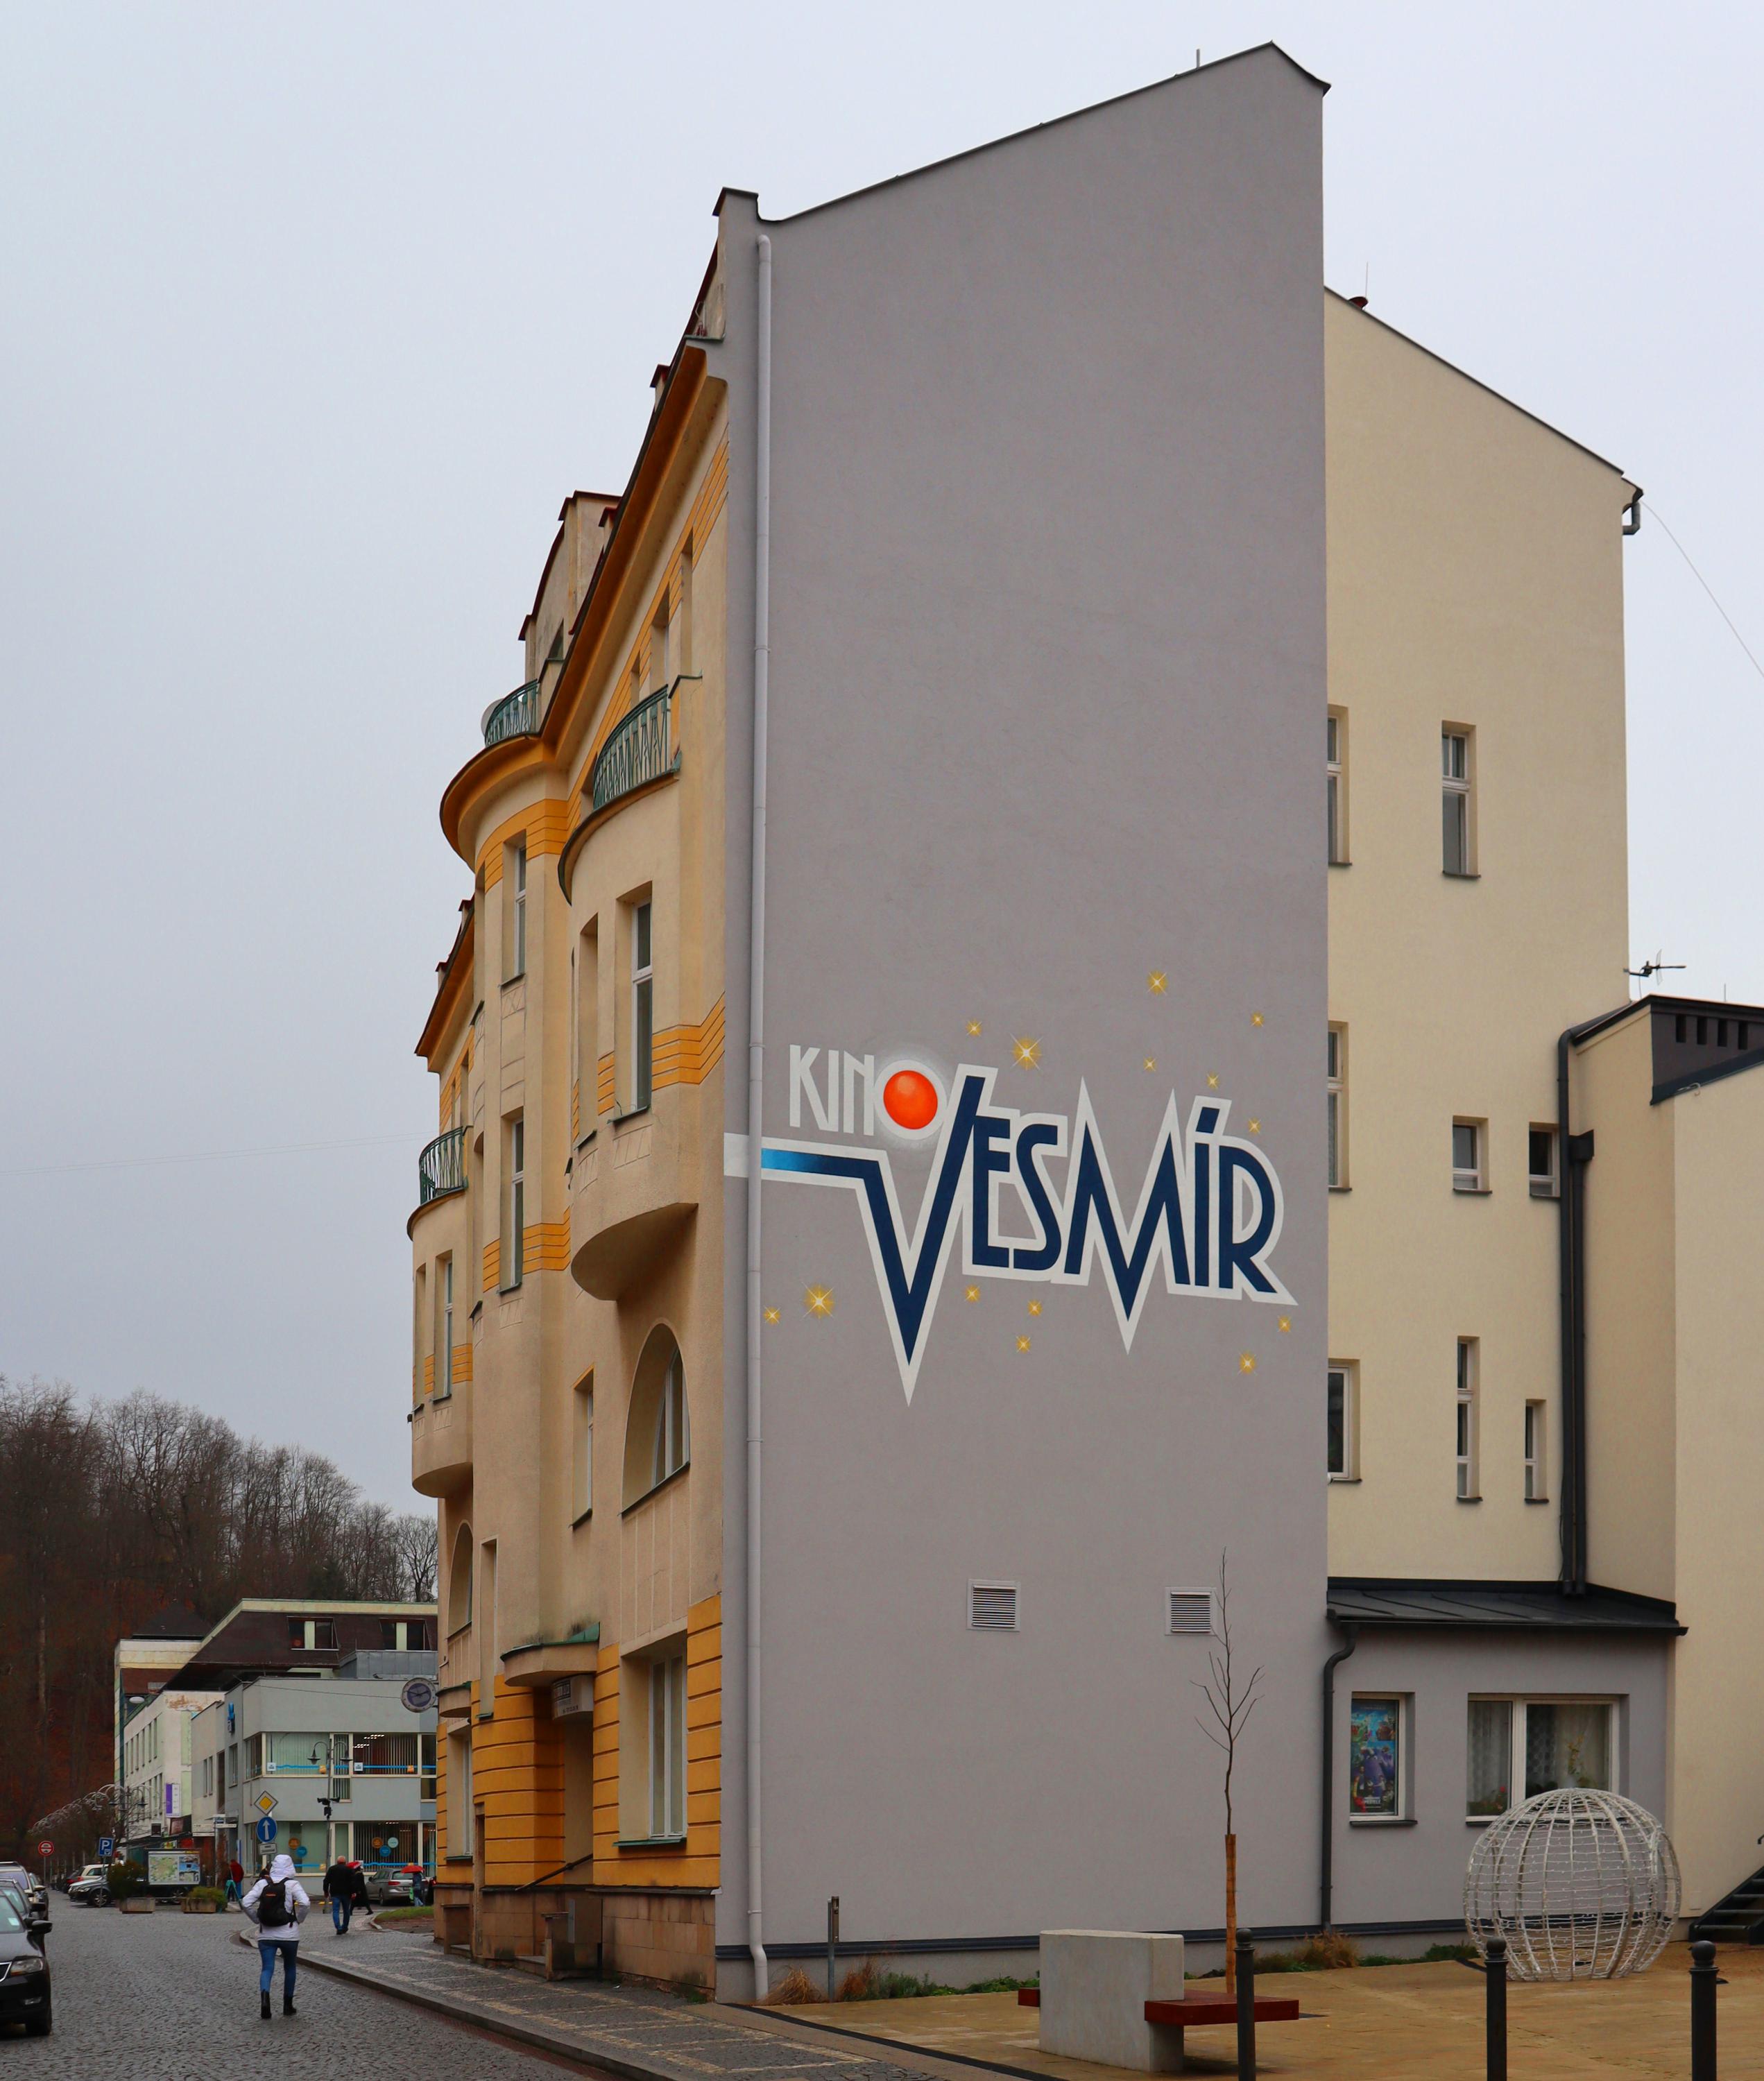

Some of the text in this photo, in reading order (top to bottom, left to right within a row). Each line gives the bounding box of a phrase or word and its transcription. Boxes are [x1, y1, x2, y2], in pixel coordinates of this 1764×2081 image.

[789, 1044, 947, 1140] KINO
[761, 1063, 1299, 1407] VESMÍR
[101, 1840, 110, 1851] P
